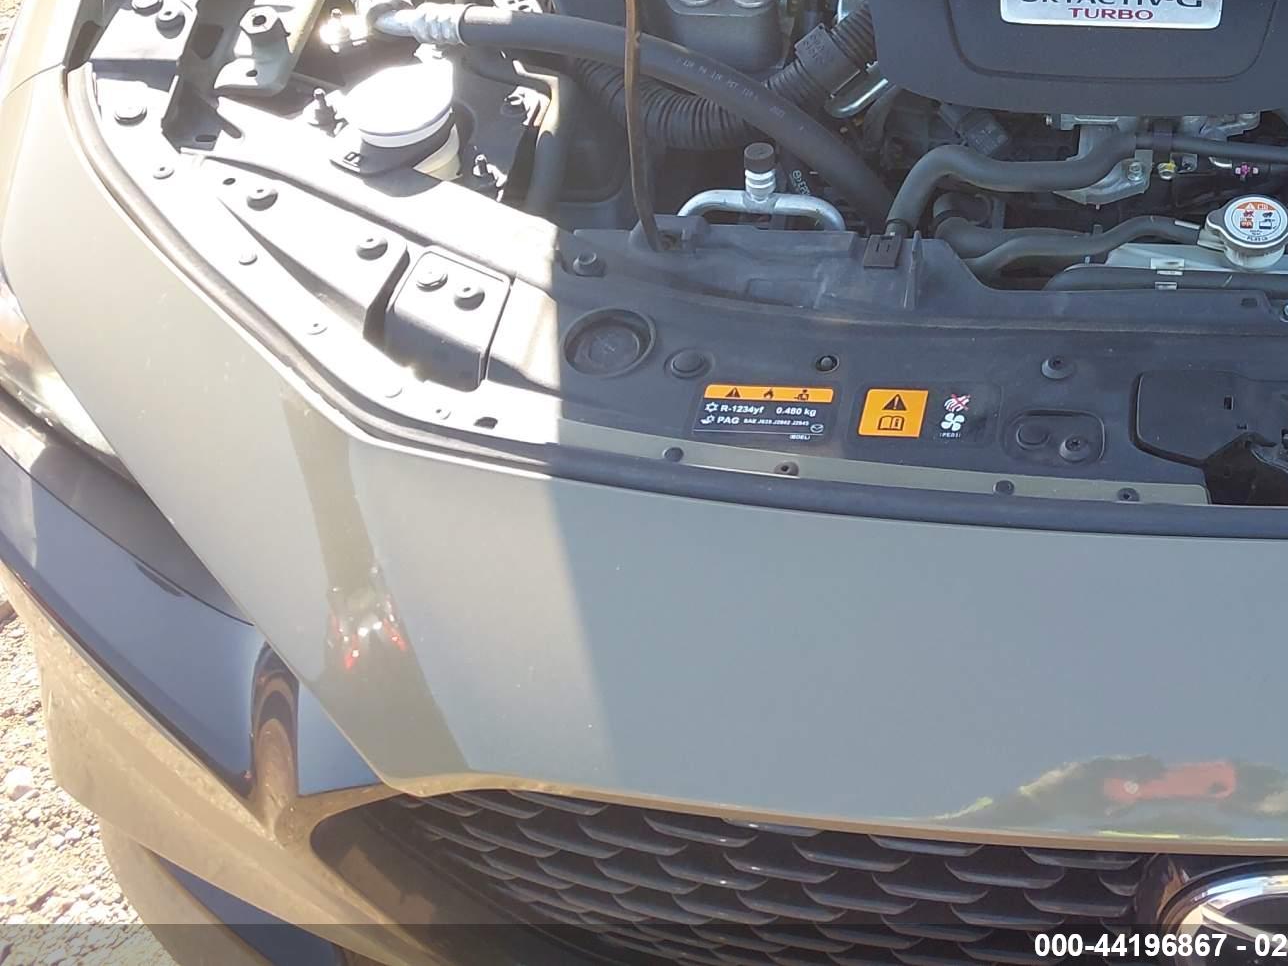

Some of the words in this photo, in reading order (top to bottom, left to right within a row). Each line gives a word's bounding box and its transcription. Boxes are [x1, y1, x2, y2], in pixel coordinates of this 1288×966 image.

[1068, 7, 1153, 20] TURBO
[720, 404, 765, 415] R-1234yf
[804, 407, 817, 417] kg
[717, 416, 740, 424] PAG
